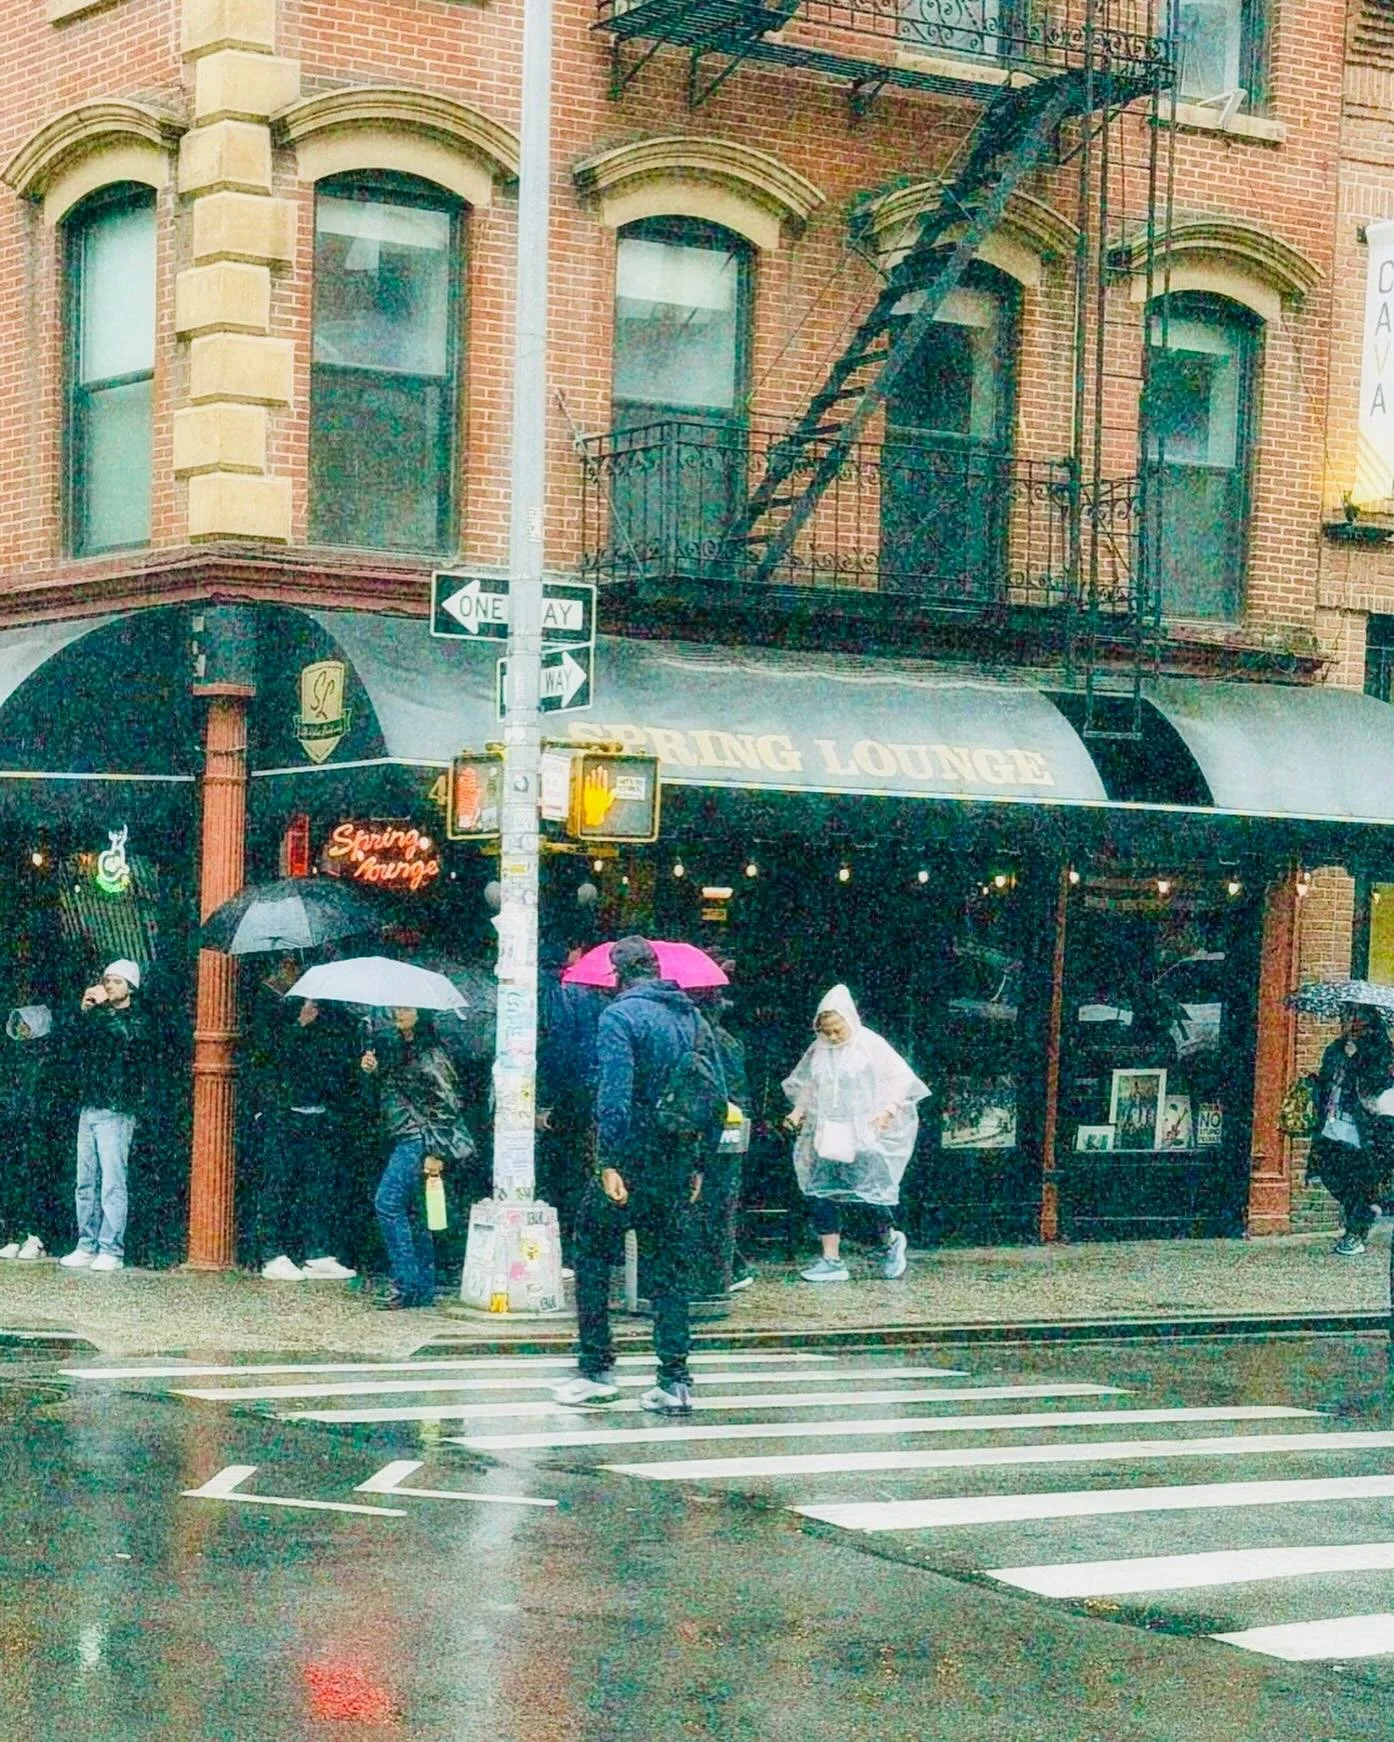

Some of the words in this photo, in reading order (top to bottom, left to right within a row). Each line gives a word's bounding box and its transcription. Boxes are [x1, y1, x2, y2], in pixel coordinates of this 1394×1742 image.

[1370, 259, 1394, 417] CAVA
[459, 595, 503, 620] ONE
[543, 603, 573, 626] AY
[545, 667, 573, 693] WAY
[814, 738, 1056, 787] LOUNGE
[328, 823, 420, 862] Spring
[1200, 1112, 1221, 1127] NO
